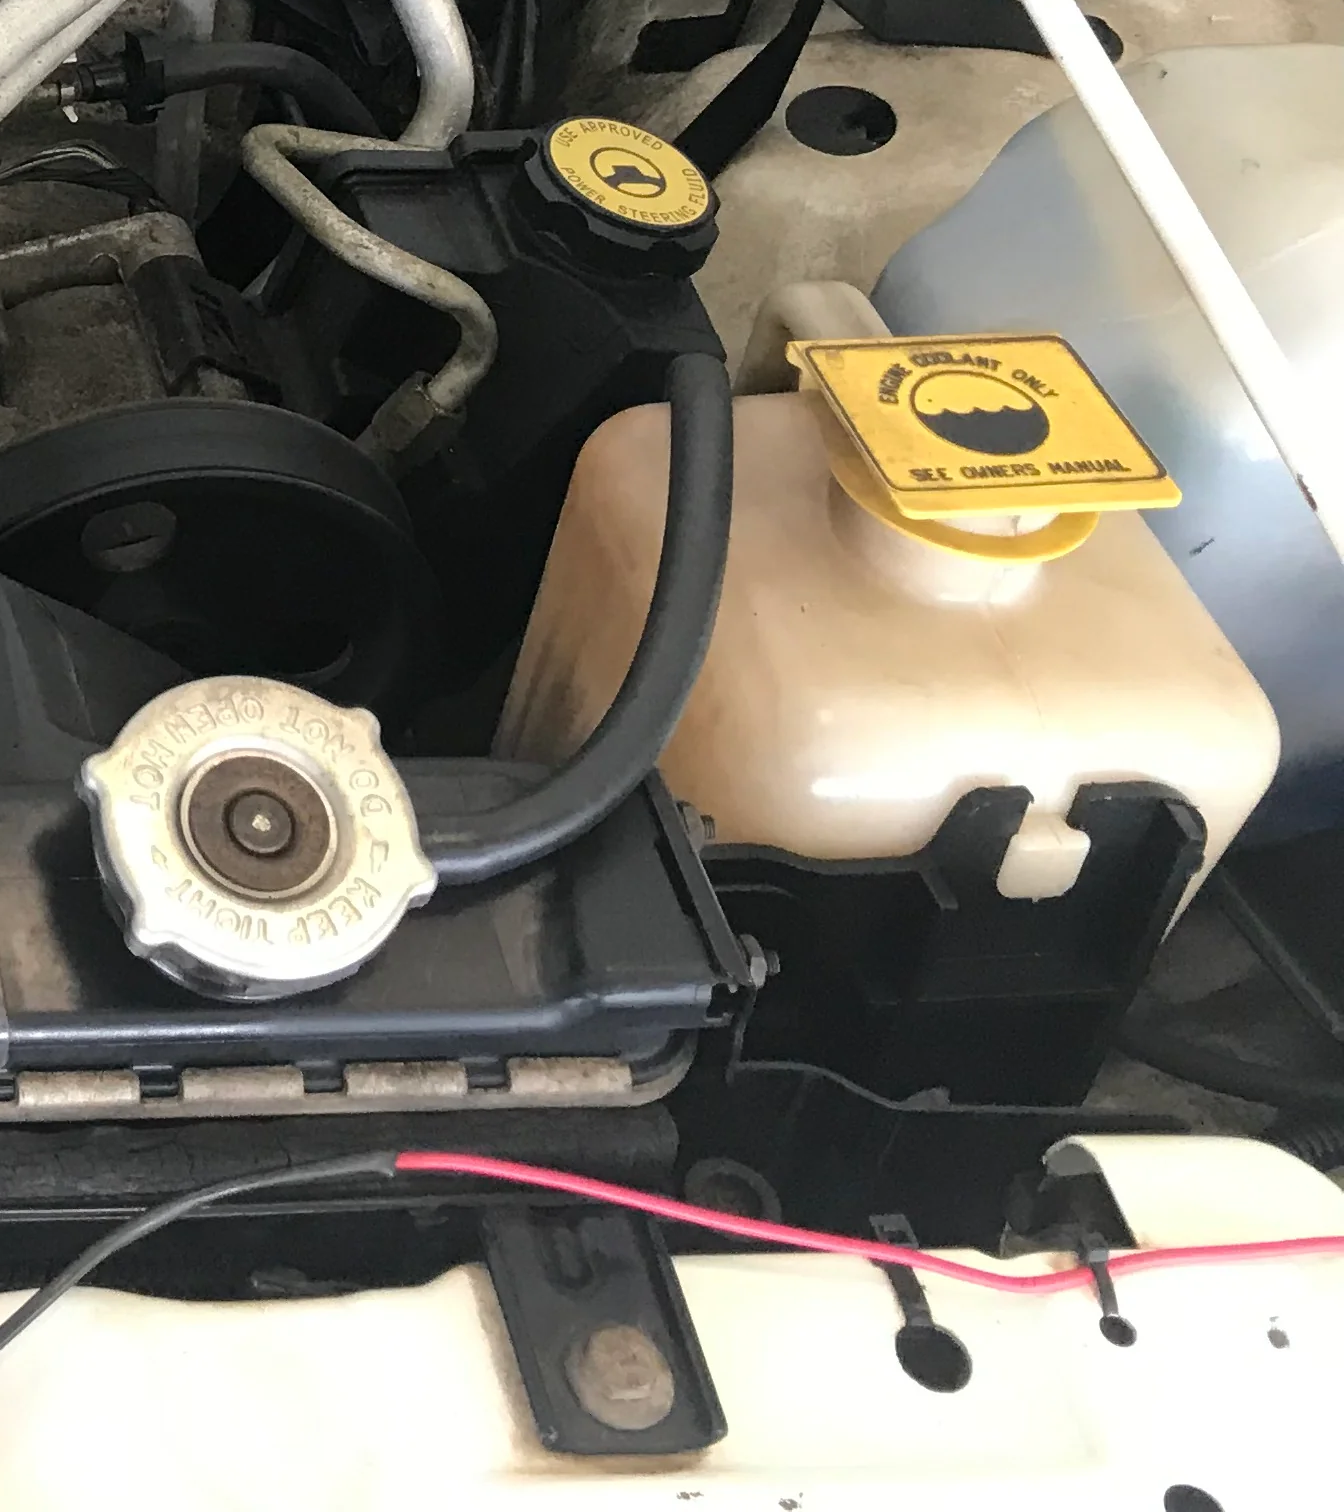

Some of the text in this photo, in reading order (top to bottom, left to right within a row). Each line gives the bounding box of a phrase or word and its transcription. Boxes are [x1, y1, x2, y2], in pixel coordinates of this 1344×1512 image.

[556, 121, 662, 151] USE APPROVED
[560, 166, 705, 224] POWER STEERING FLUID
[878, 351, 1059, 405] ENGINE COOLANT ONLY
[909, 458, 1131, 481] SEE OWNERS MANUAL
[164, 695, 264, 744] OPEN
[279, 706, 354, 762] NOT
[130, 737, 174, 811] HOT
[166, 878, 381, 945] KEEP TIGHT
